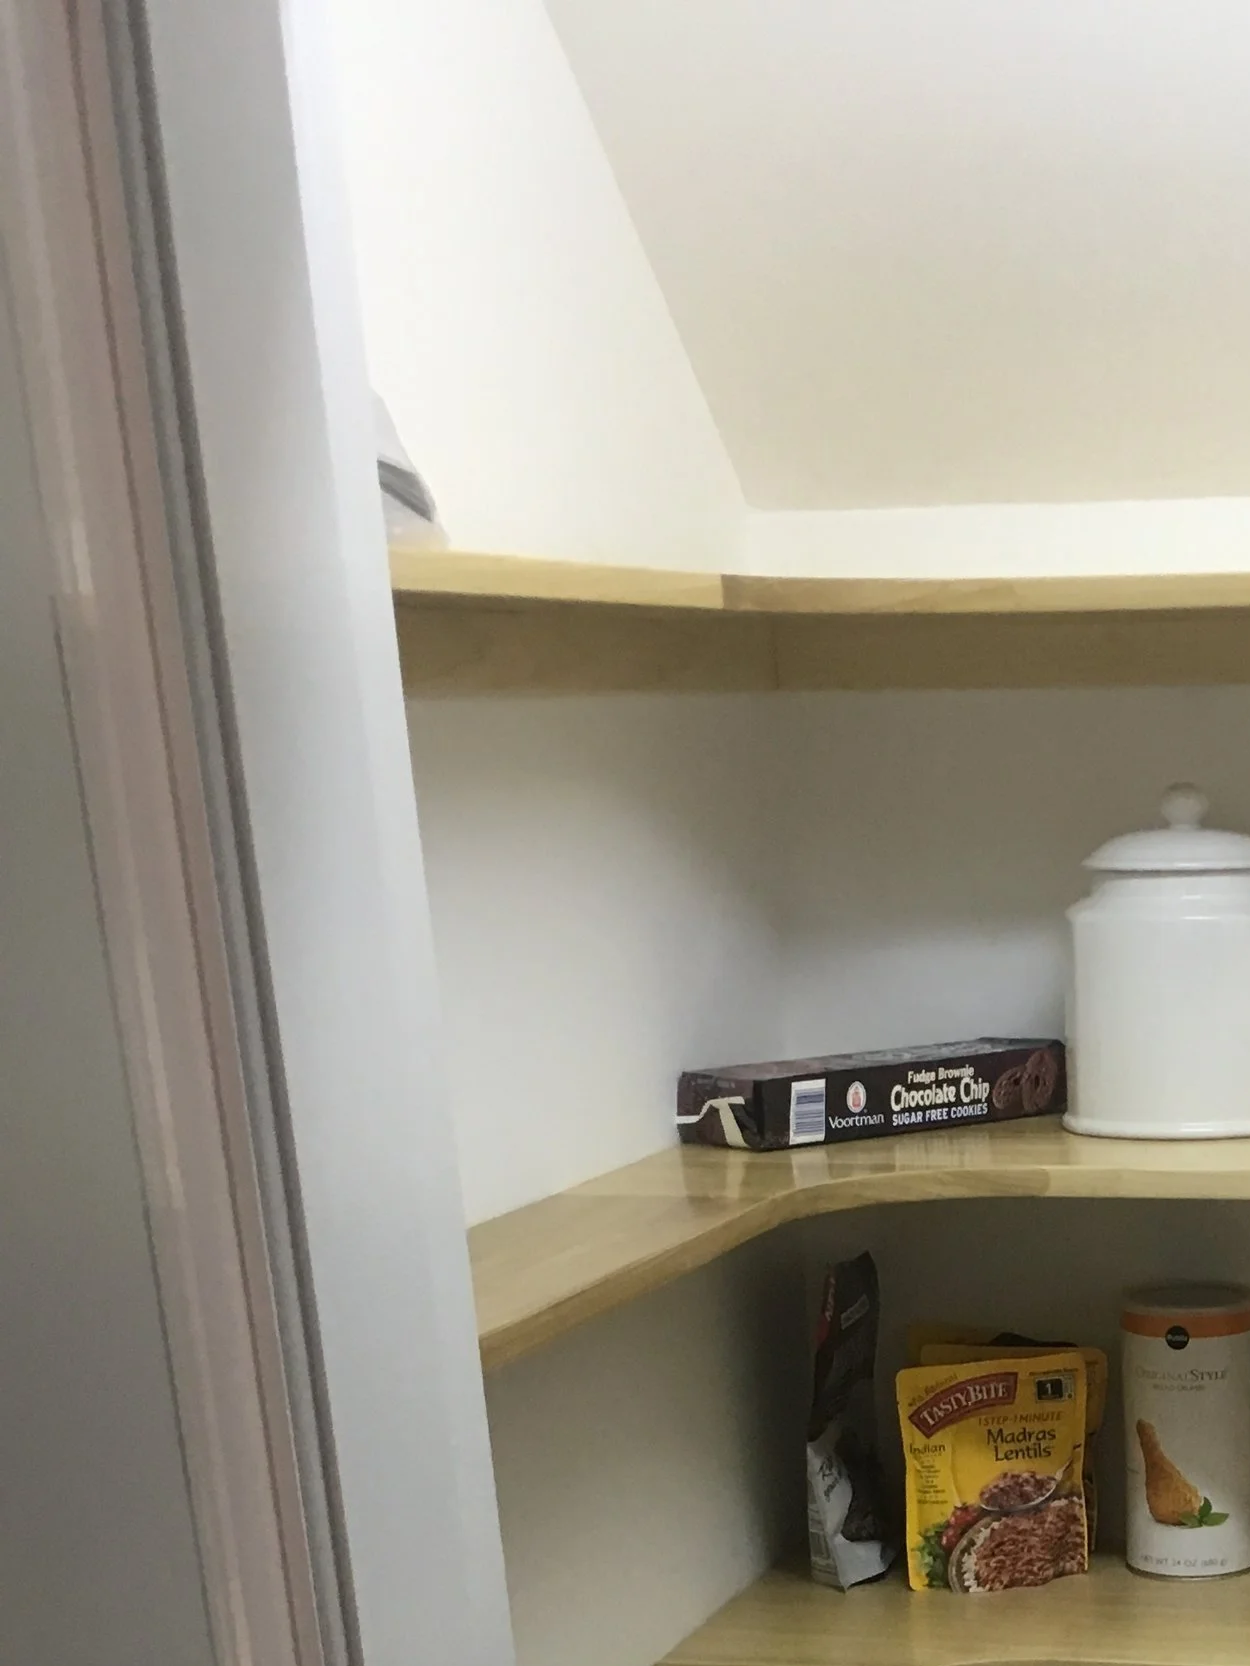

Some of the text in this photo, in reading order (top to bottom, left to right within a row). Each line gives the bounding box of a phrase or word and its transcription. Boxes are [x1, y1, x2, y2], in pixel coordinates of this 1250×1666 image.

[907, 1064, 975, 1085] Fudge Brownie
[890, 1077, 990, 1112] Chocolate Chip
[828, 1113, 885, 1129] Voortman
[892, 1103, 988, 1126] SUGAR FREE COOKIES
[1045, 1383, 1052, 1395] 1
[920, 1390, 970, 1427] TASTY
[967, 1381, 1009, 1401] BITE
[986, 1427, 1057, 1446] Madras
[909, 1442, 946, 1455] Indian
[994, 1445, 1053, 1462] Lentils
